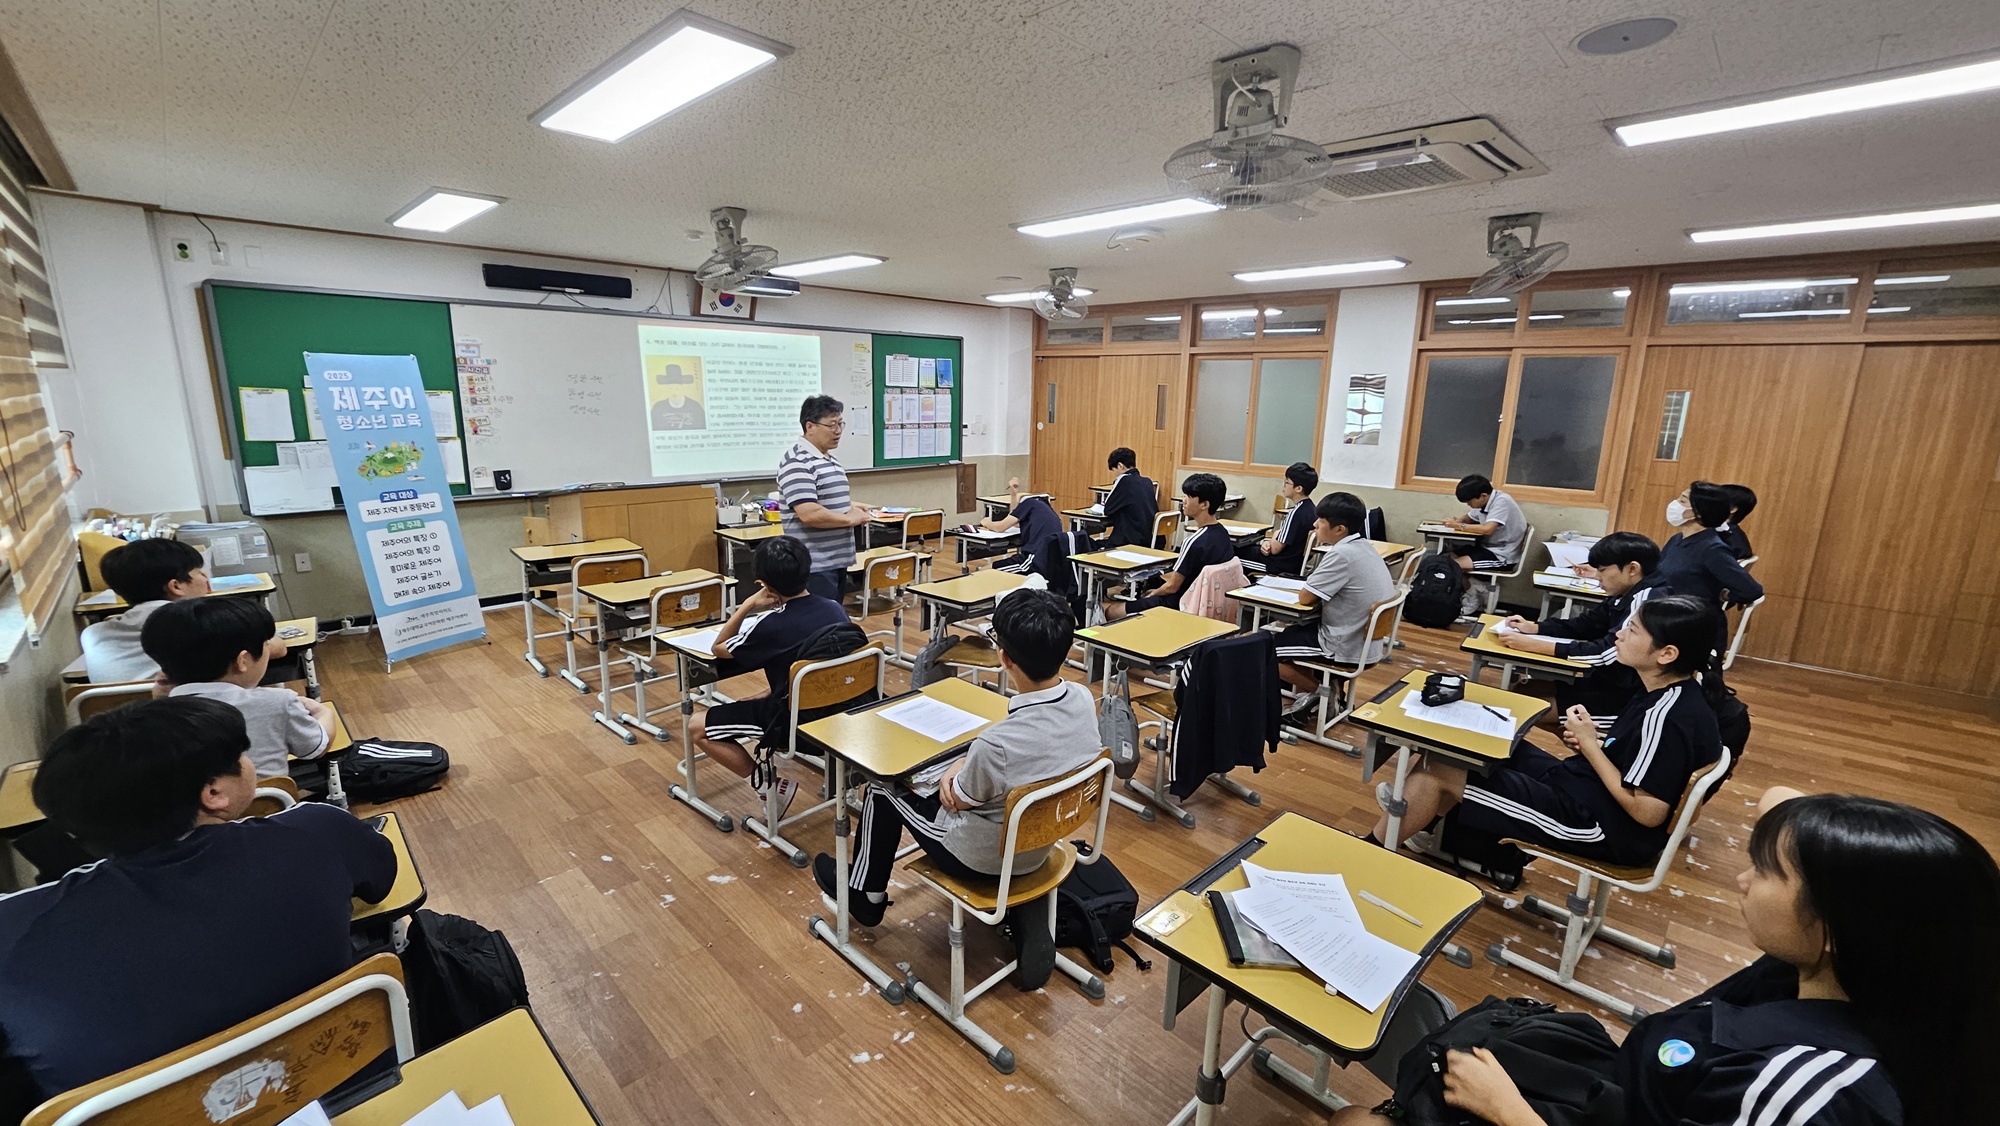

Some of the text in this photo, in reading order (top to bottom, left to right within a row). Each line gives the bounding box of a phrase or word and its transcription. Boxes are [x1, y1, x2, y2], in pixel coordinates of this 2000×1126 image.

[327, 372, 349, 380] 2025
[328, 386, 417, 411] 제주어
[336, 413, 422, 431] 청소년 교육
[383, 490, 414, 501] 교육 대상
[366, 508, 381, 516] 제주
[383, 506, 398, 514] 지역
[409, 501, 436, 512] 중등학교
[390, 519, 422, 531] 교육 주제
[381, 536, 412, 547] 제주어의
[413, 534, 428, 543] 특징
[384, 549, 414, 560] 제주어의
[416, 546, 431, 555] 특징
[390, 557, 442, 573] 흥미로운 제주어
[396, 570, 442, 585] 제주어 글쓰기
[411, 586, 426, 595] 속의
[427, 580, 451, 591] 제주어
